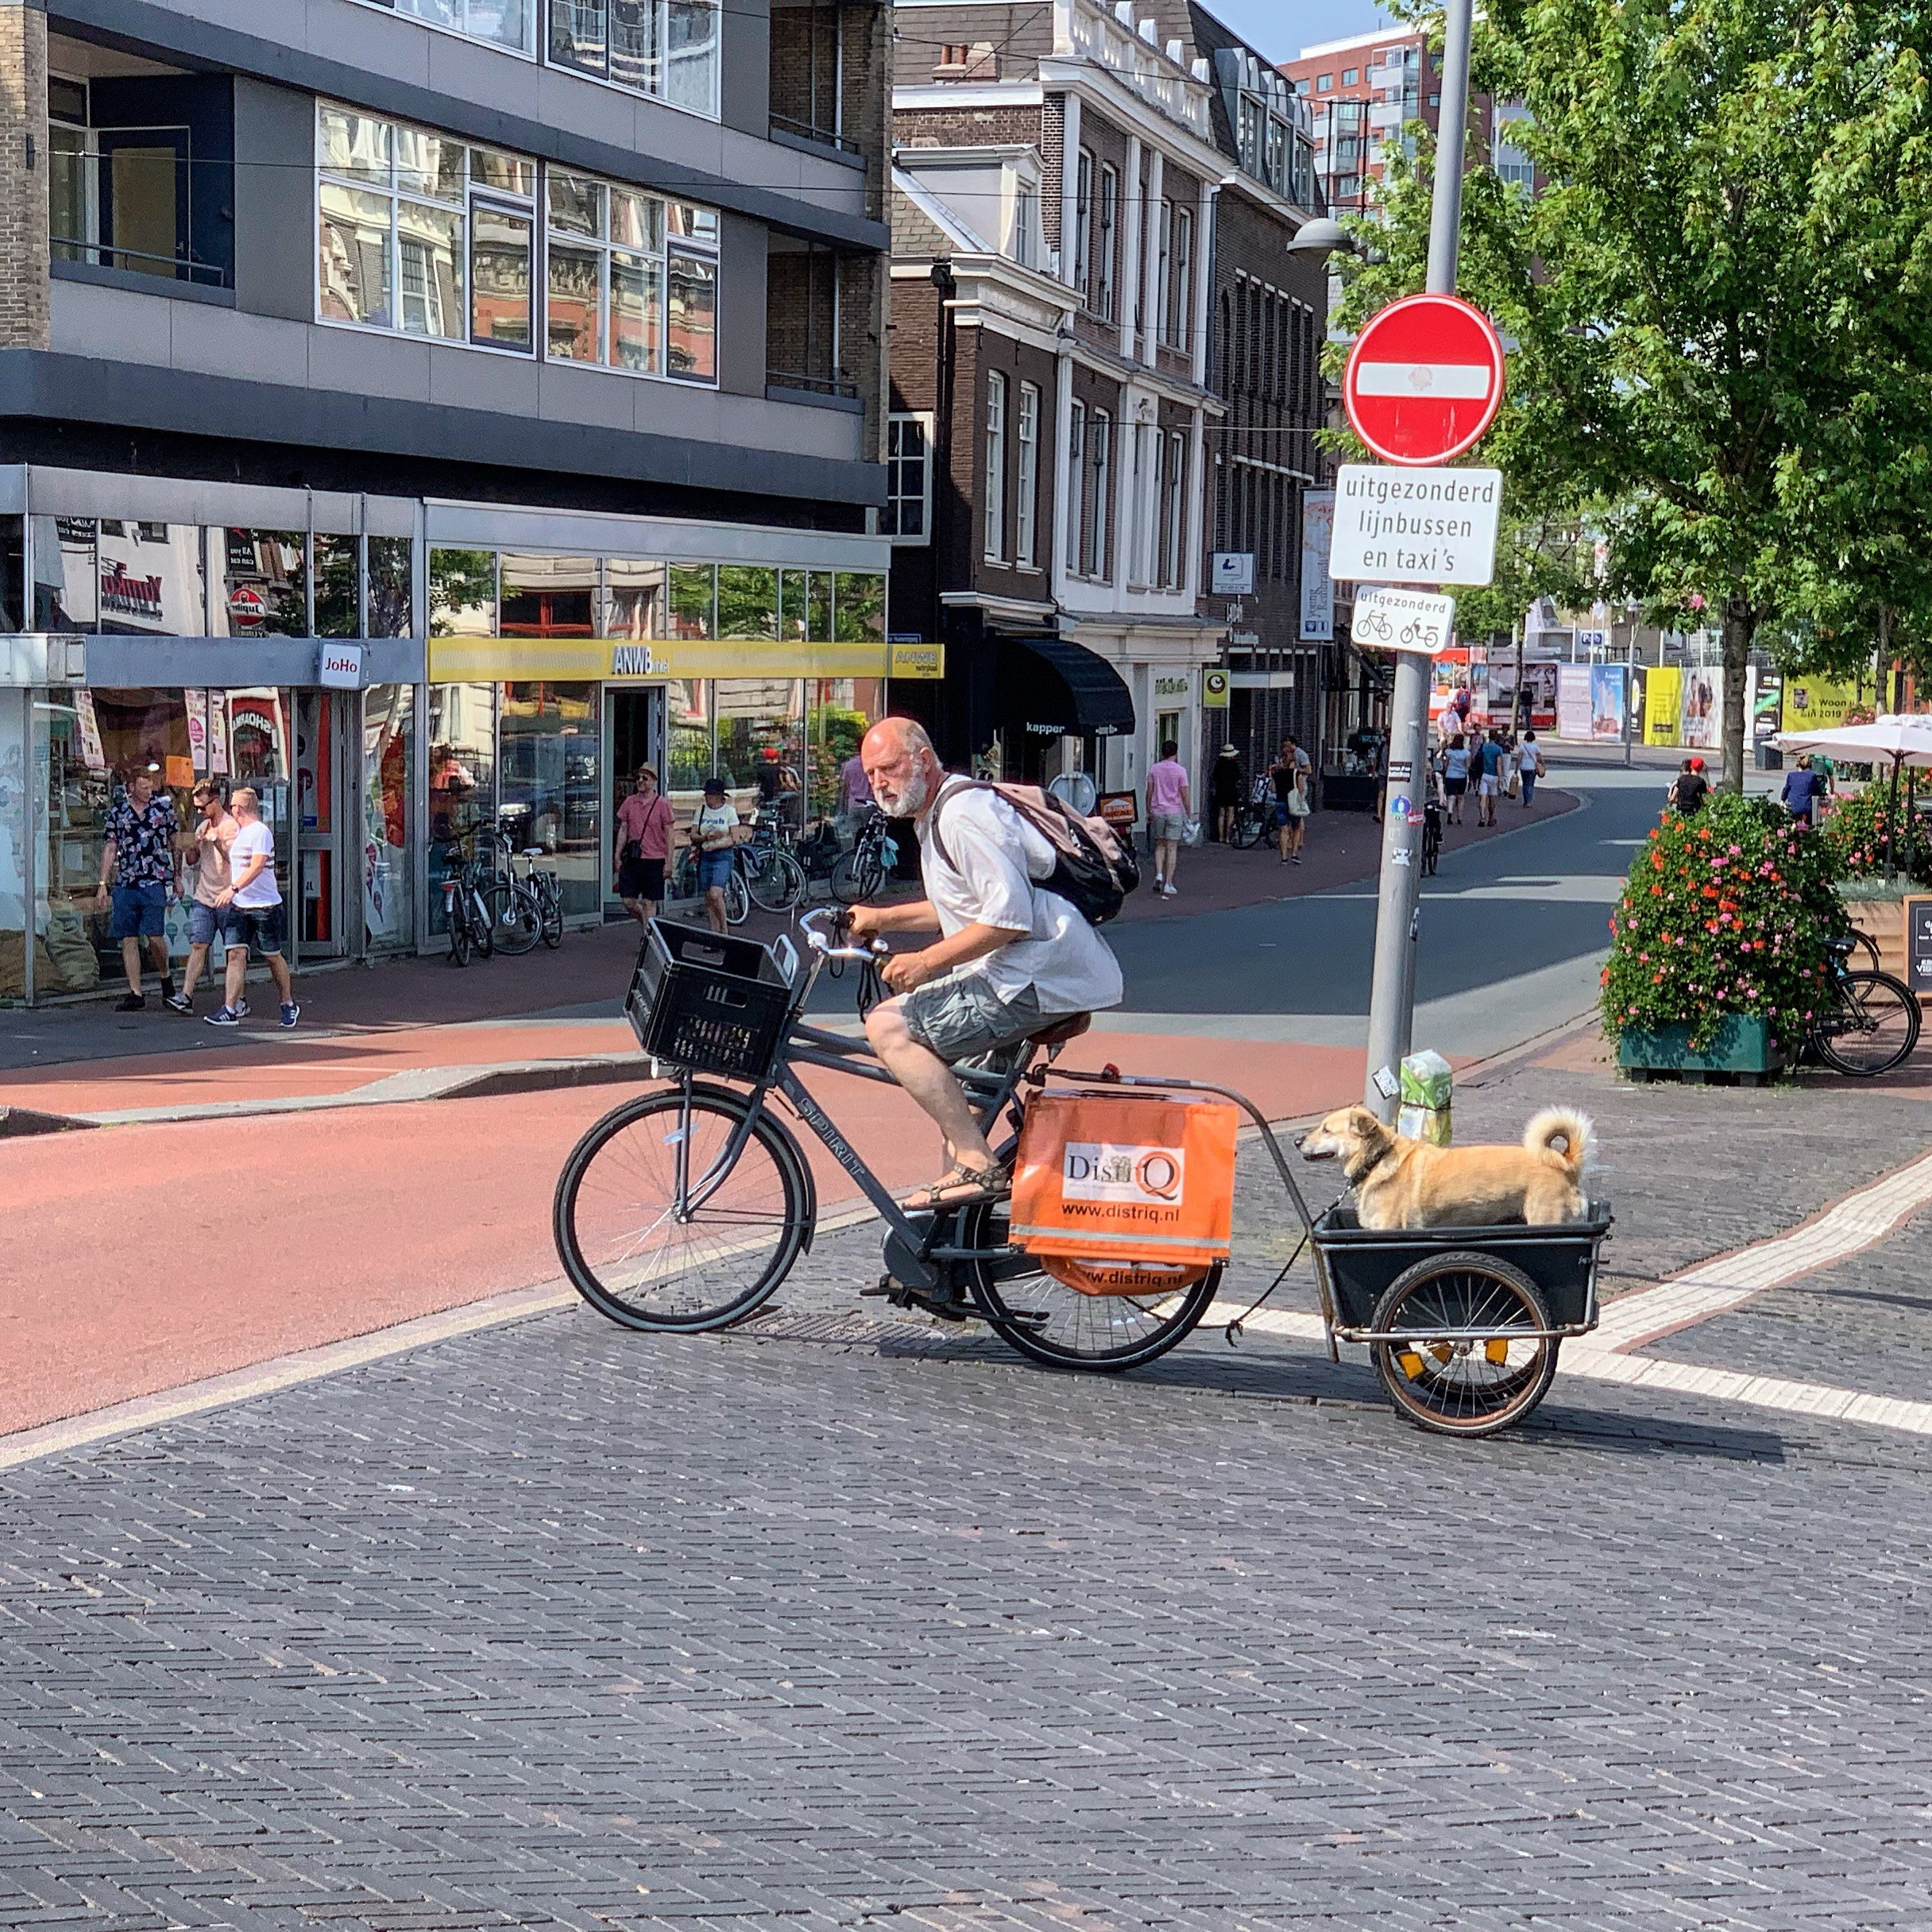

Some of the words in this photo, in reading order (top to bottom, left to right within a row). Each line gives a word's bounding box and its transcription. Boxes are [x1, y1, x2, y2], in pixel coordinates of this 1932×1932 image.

[1346, 474, 1494, 504] uitgezonderd
[1359, 510, 1472, 539] lijnbussen
[1363, 550, 1387, 568] en
[1397, 548, 1455, 571] taxi's
[1361, 592, 1447, 613] uitgezonderd
[325, 657, 357, 673] JoHo
[612, 646, 652, 674] ANWB
[895, 651, 938, 663] ANWB
[1819, 709, 1842, 718] 2019
[797, 1097, 865, 1175] SPIRIT
[1062, 1204, 1180, 1223] www.distriq.nl
